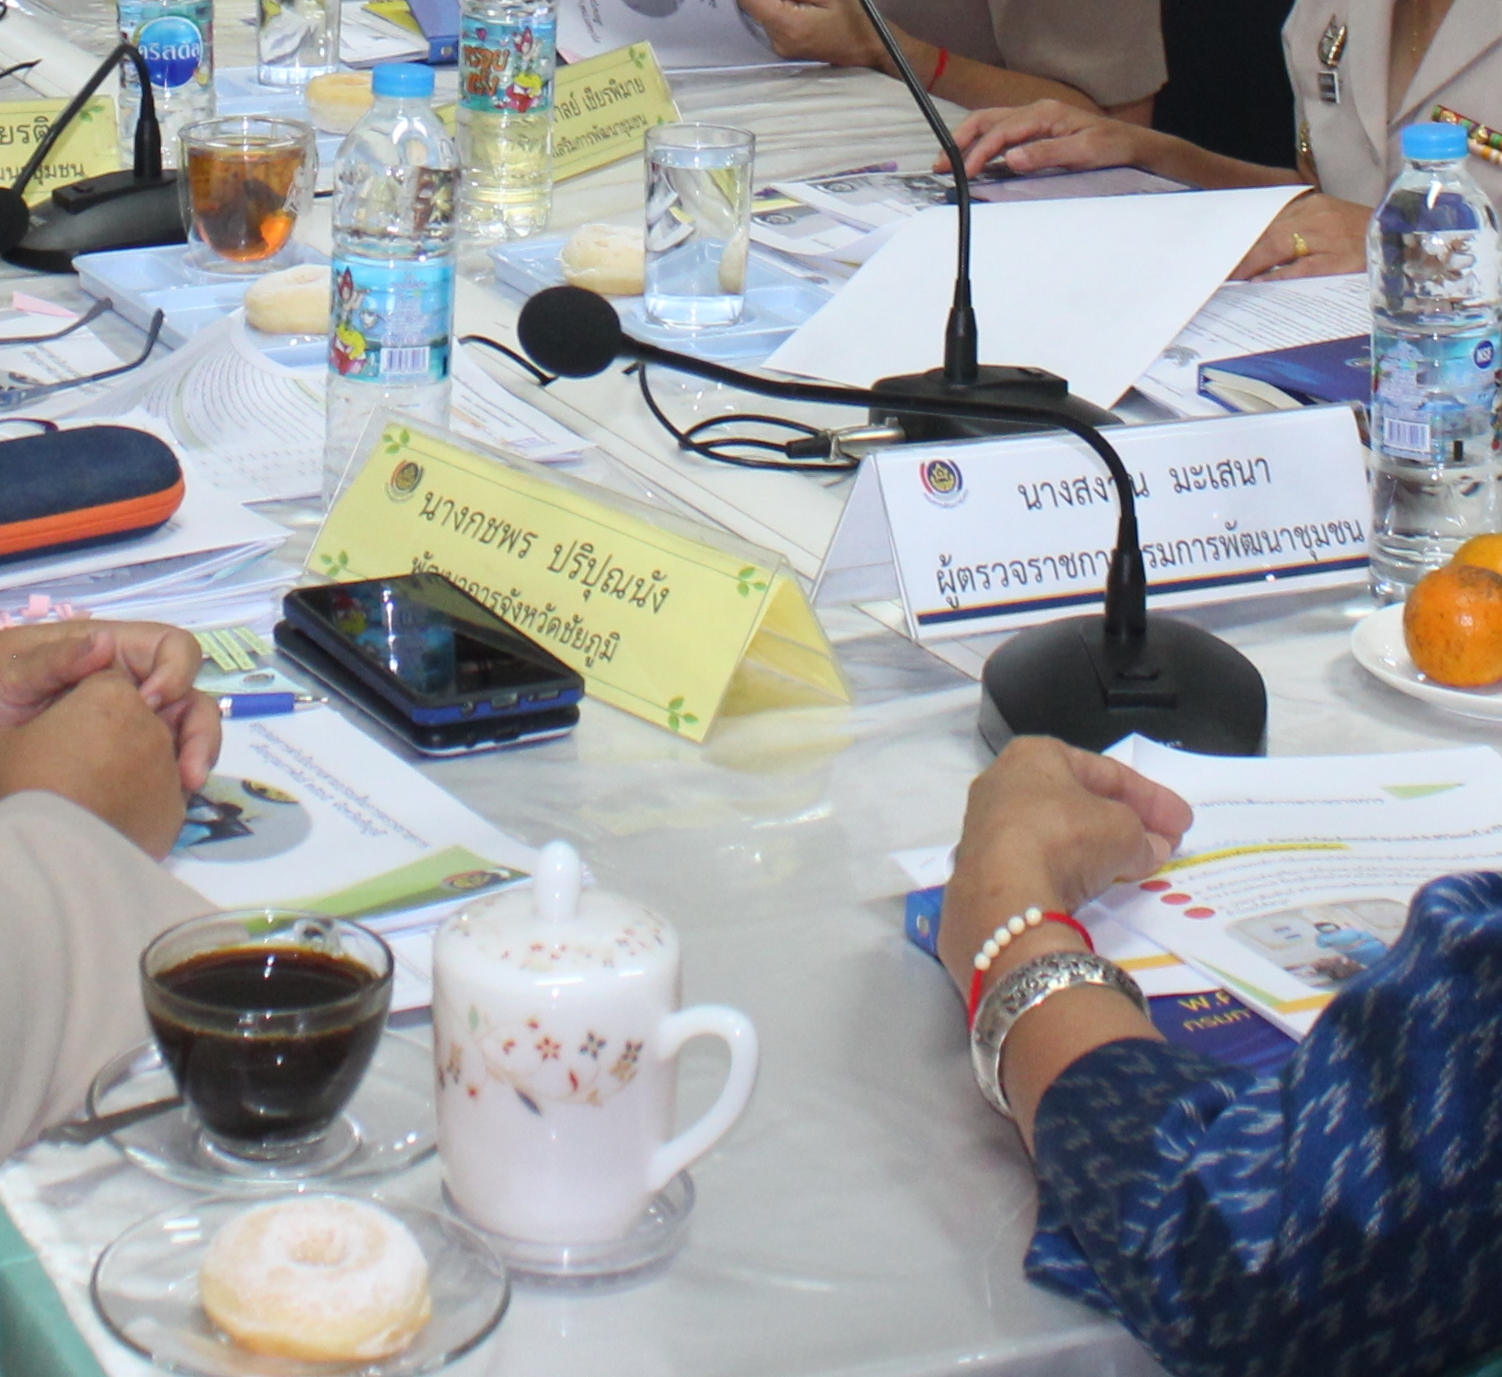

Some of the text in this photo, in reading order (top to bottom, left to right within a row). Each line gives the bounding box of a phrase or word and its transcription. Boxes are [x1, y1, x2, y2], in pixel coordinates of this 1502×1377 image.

[1168, 455, 1273, 494] มะเสนา
[418, 490, 671, 615] นางกชพร ปริปุณนัง
[935, 517, 1365, 608] ผู้ตรวจราชการมการพัฒนาชุมชน
